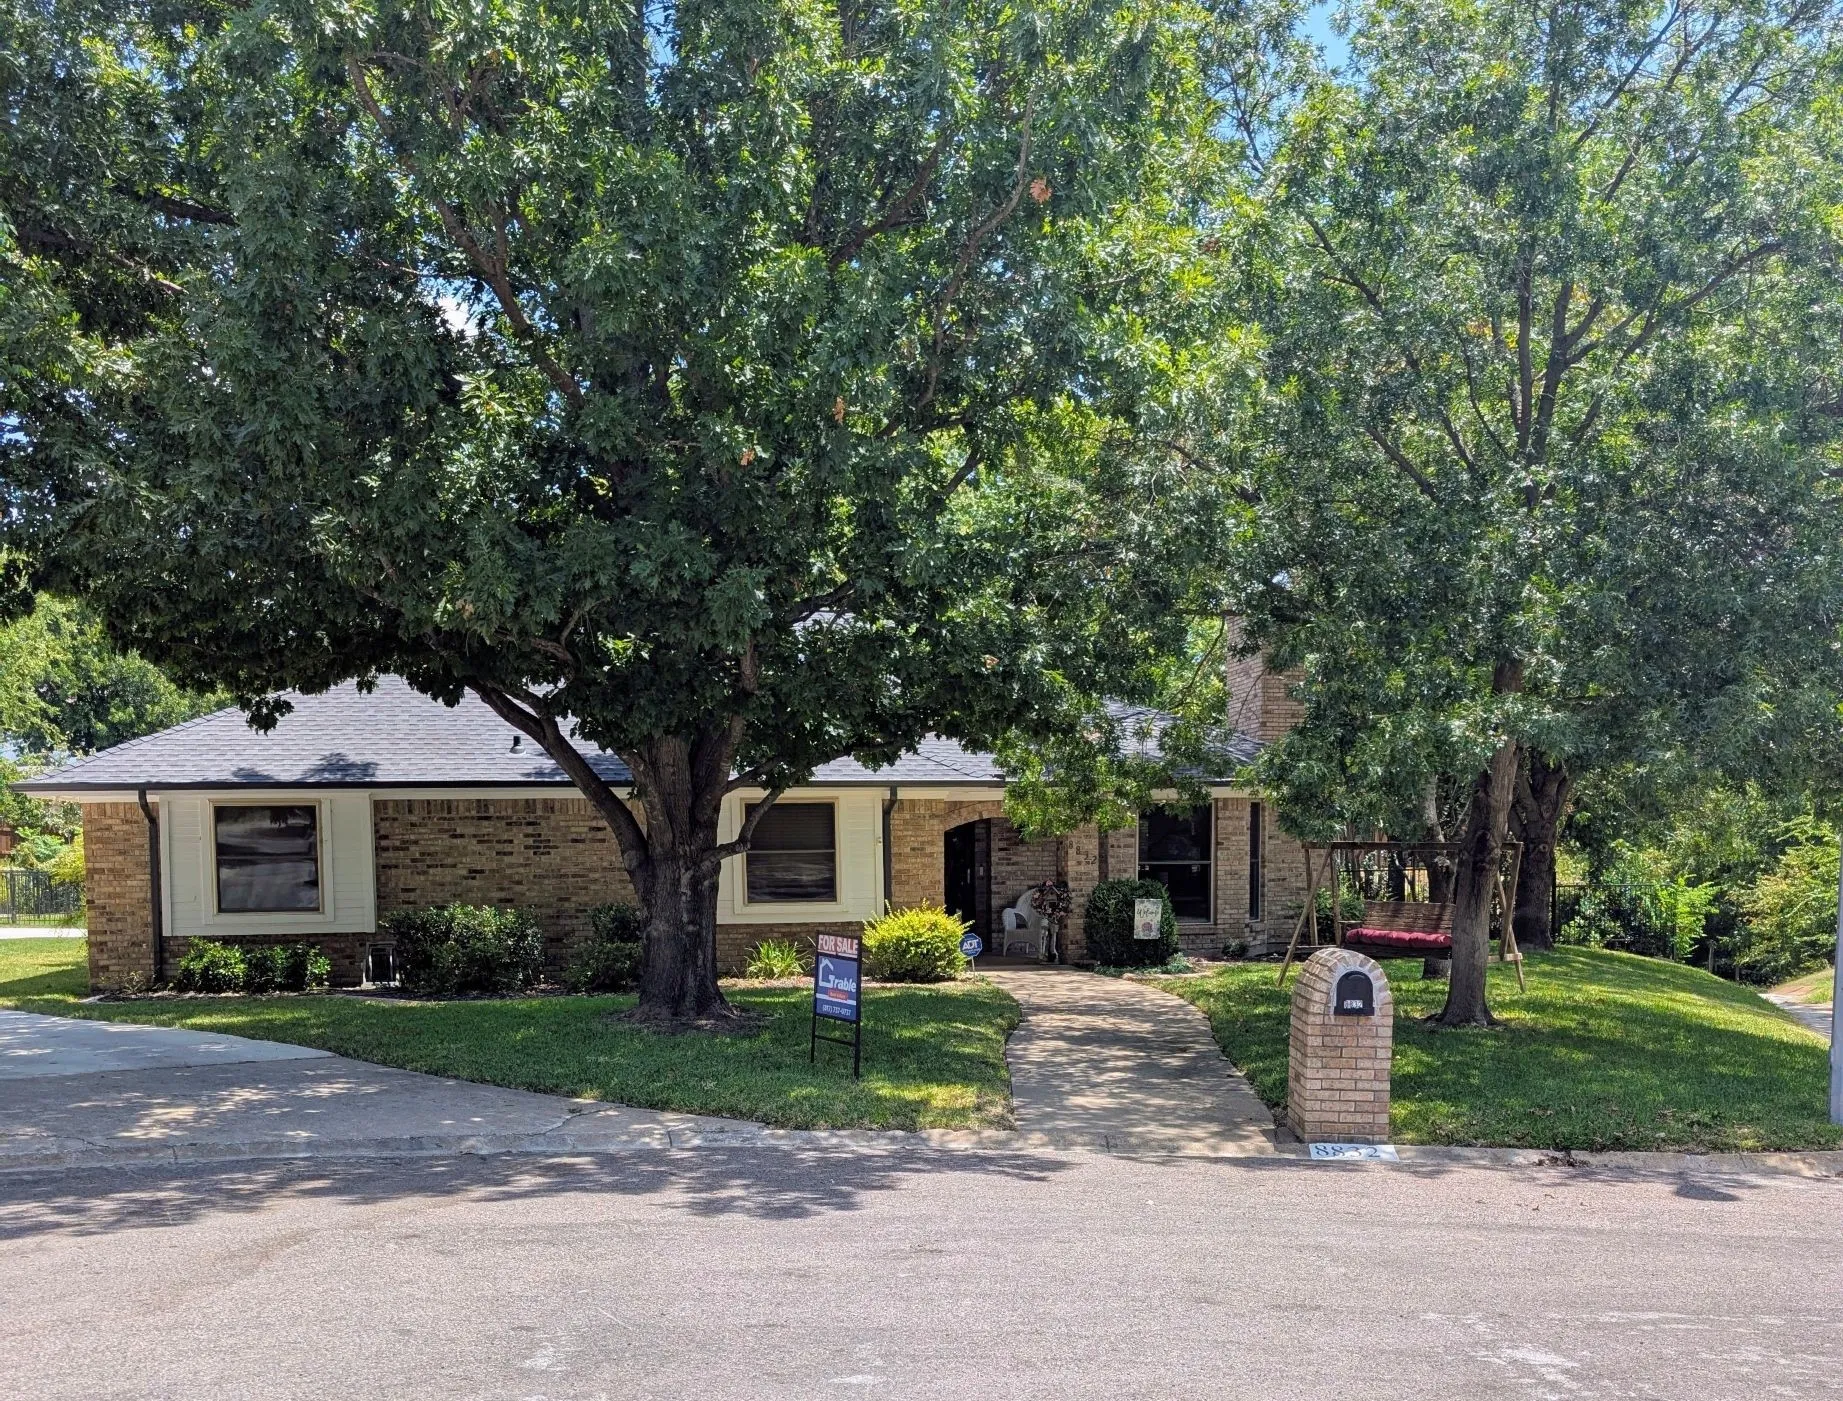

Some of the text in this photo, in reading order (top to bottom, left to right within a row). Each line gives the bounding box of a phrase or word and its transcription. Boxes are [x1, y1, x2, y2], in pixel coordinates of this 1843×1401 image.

[818, 934, 858, 955] FOR SALE
[962, 939, 979, 950] ADT
[1314, 1144, 1381, 1158] 8832
